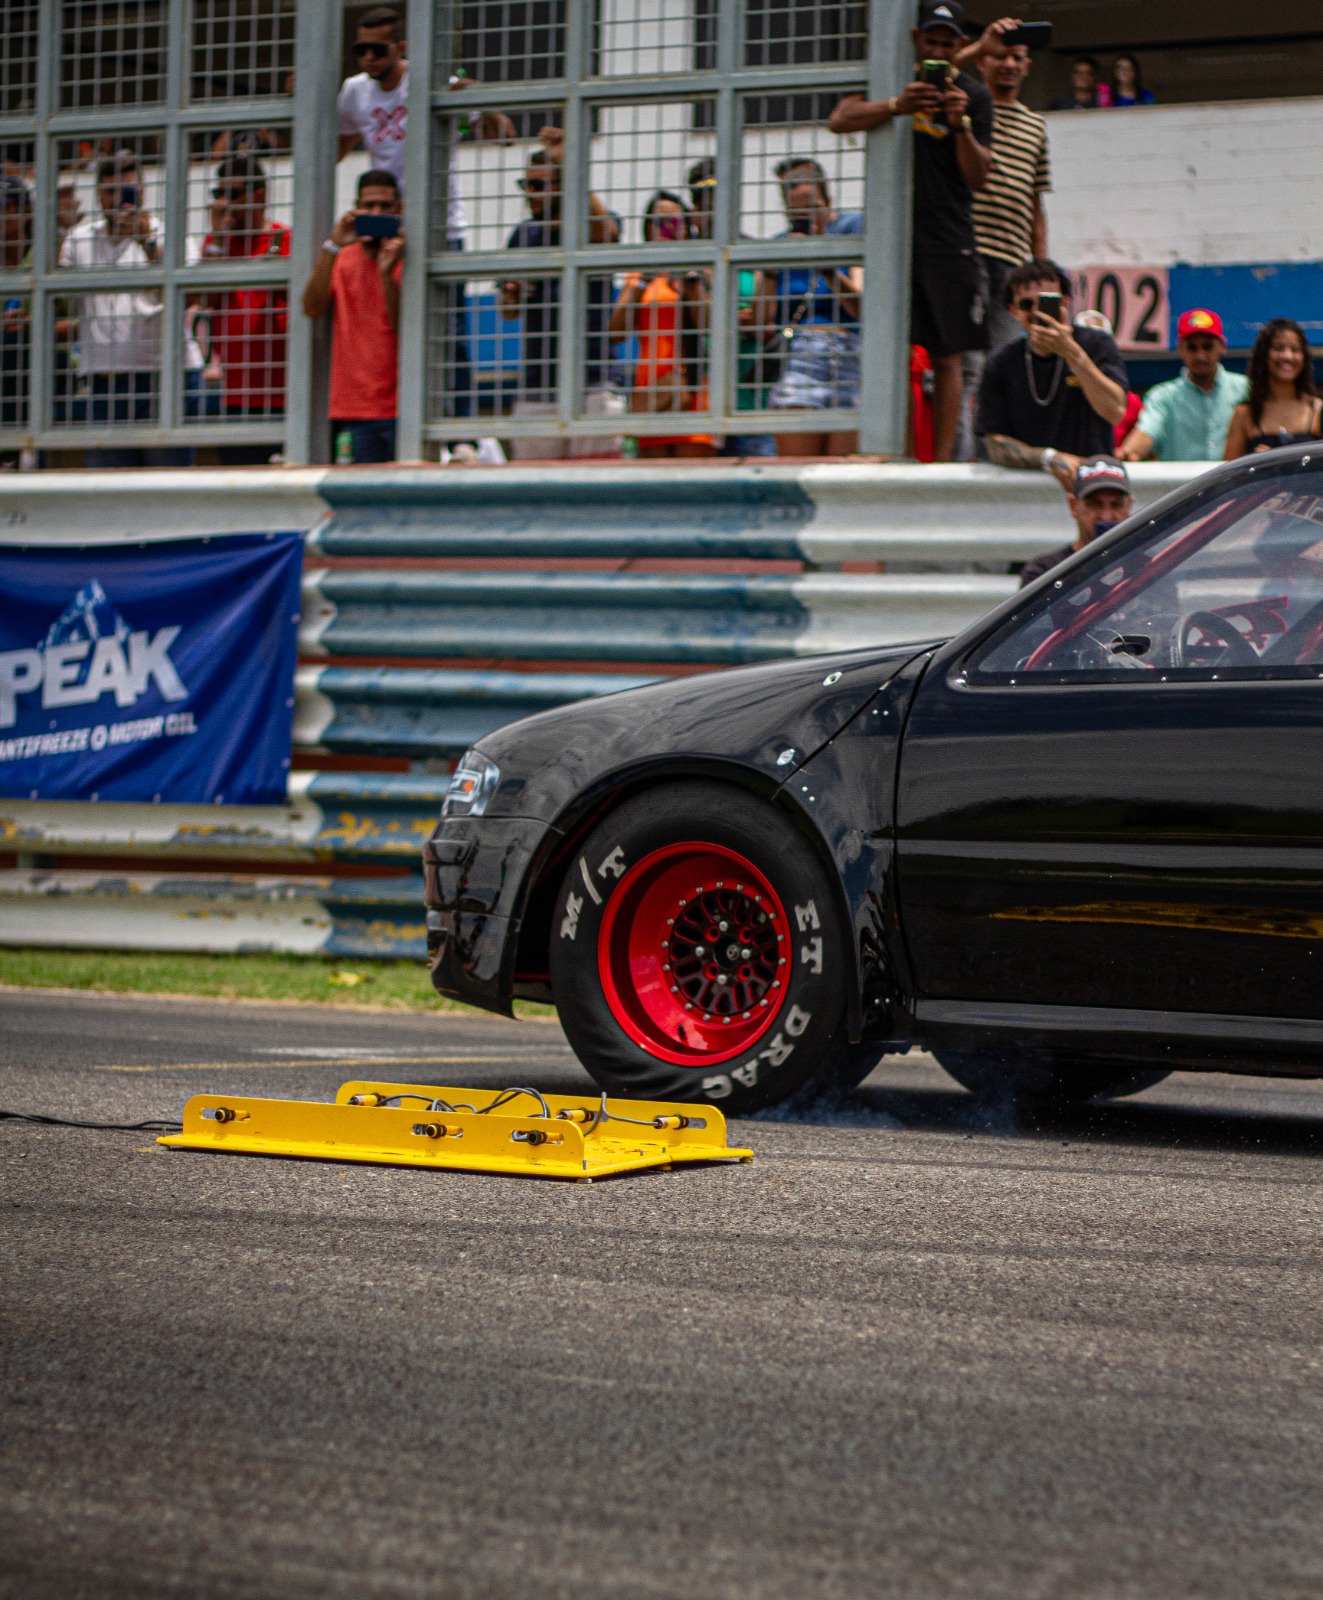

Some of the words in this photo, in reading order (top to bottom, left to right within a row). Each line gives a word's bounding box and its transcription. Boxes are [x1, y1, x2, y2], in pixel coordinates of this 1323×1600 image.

[0, 624, 189, 728] PEAK
[108, 715, 164, 746] MOTOR
[165, 712, 198, 737] OIL
[560, 845, 627, 941] M/T
[794, 899, 823, 975] ET
[701, 1003, 812, 1099] DRAG
